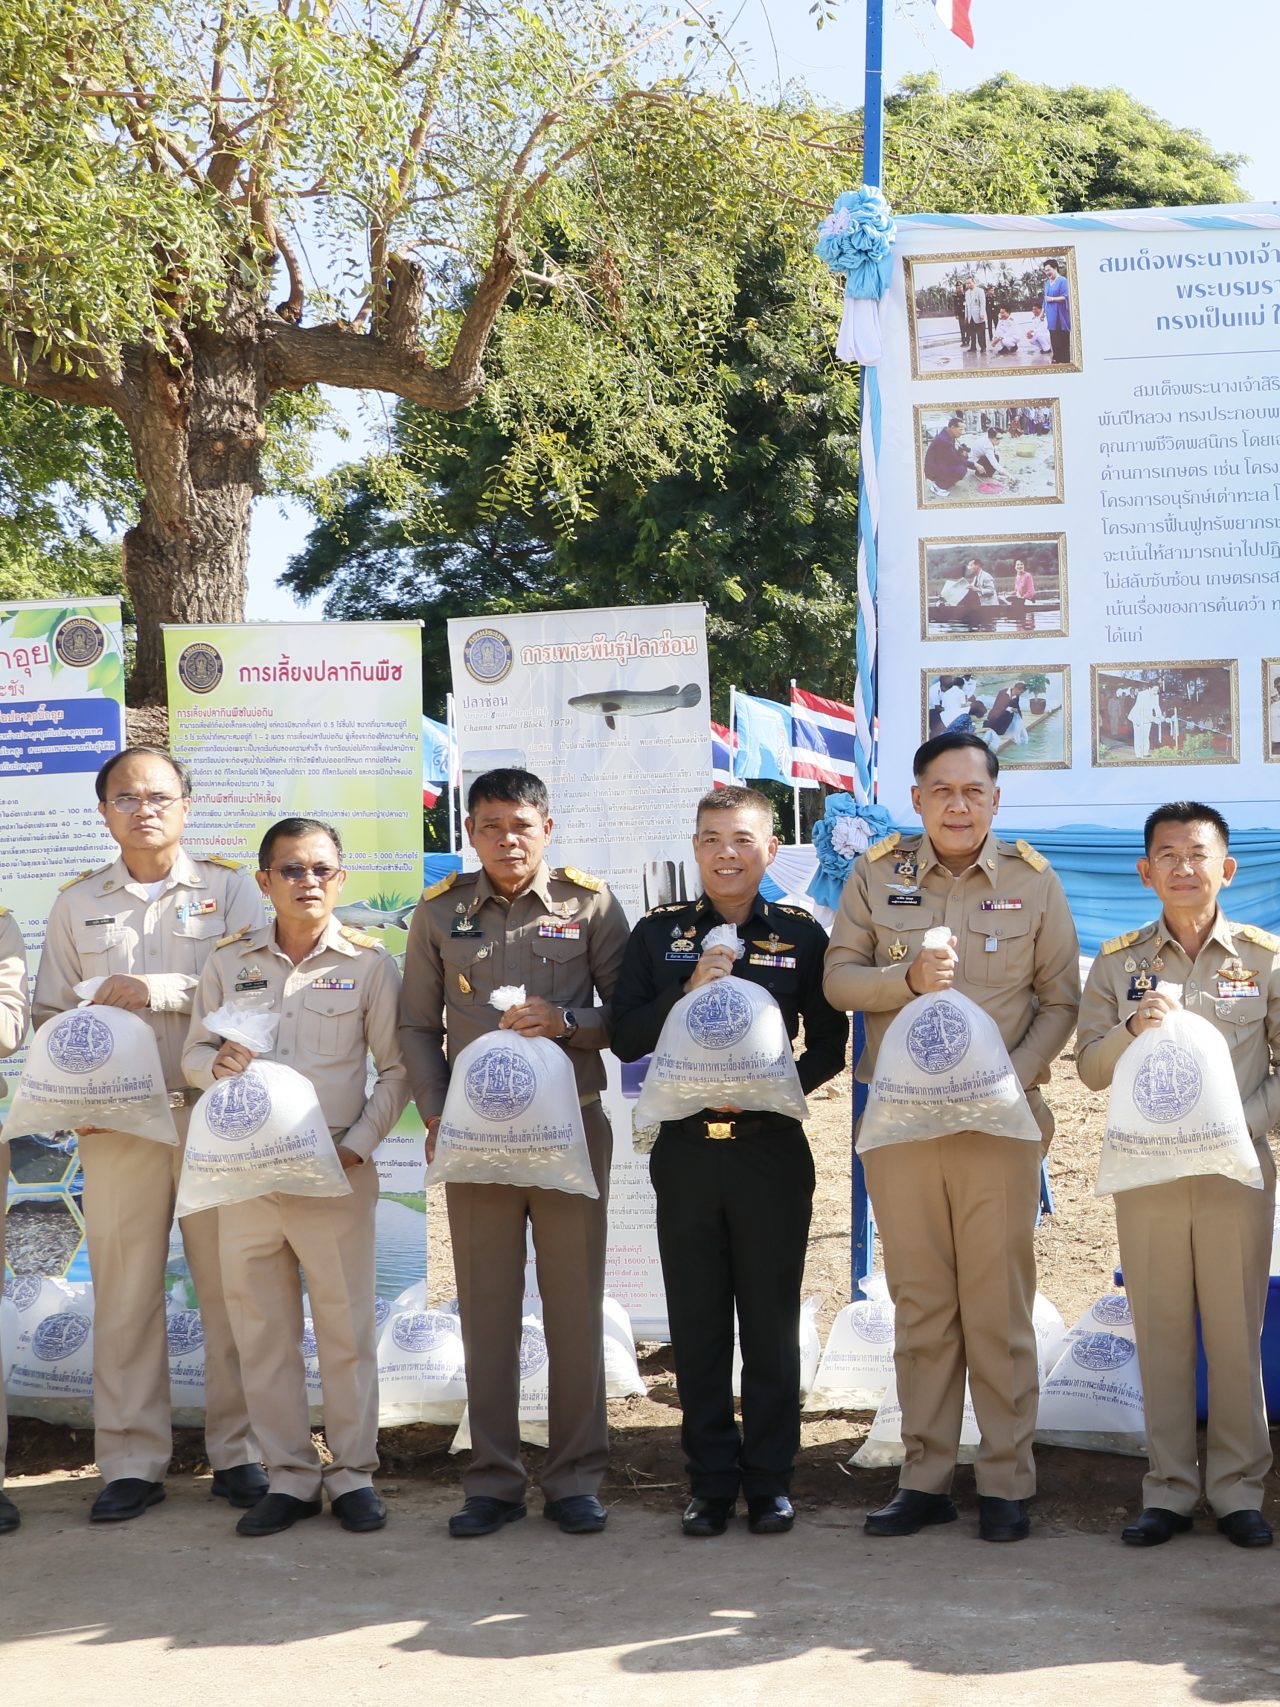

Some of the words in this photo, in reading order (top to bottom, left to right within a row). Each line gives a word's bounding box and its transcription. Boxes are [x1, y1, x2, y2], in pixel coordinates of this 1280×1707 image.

[1157, 303, 1266, 330] ทรงเป็นแม่
[1098, 410, 1171, 426] พันปีหลวง
[1101, 464, 1208, 480] ด้านการเกษตร
[1214, 460, 1240, 476] เช่น
[1100, 487, 1269, 509] โครงการอนุรักษ์เต่าทะเล
[1104, 570, 1200, 589] ไม่สลับซับซ้อน
[1105, 595, 1266, 616] เน้นเรื่องของการค้นคว้า
[1105, 625, 1143, 643] ได้แก่
[522, 630, 697, 666] การเพาะพันธุ์ปลาช่อน
[239, 653, 403, 682] การเลี้ยงปลากินพืช
[463, 692, 508, 709] ปลาช่อน
